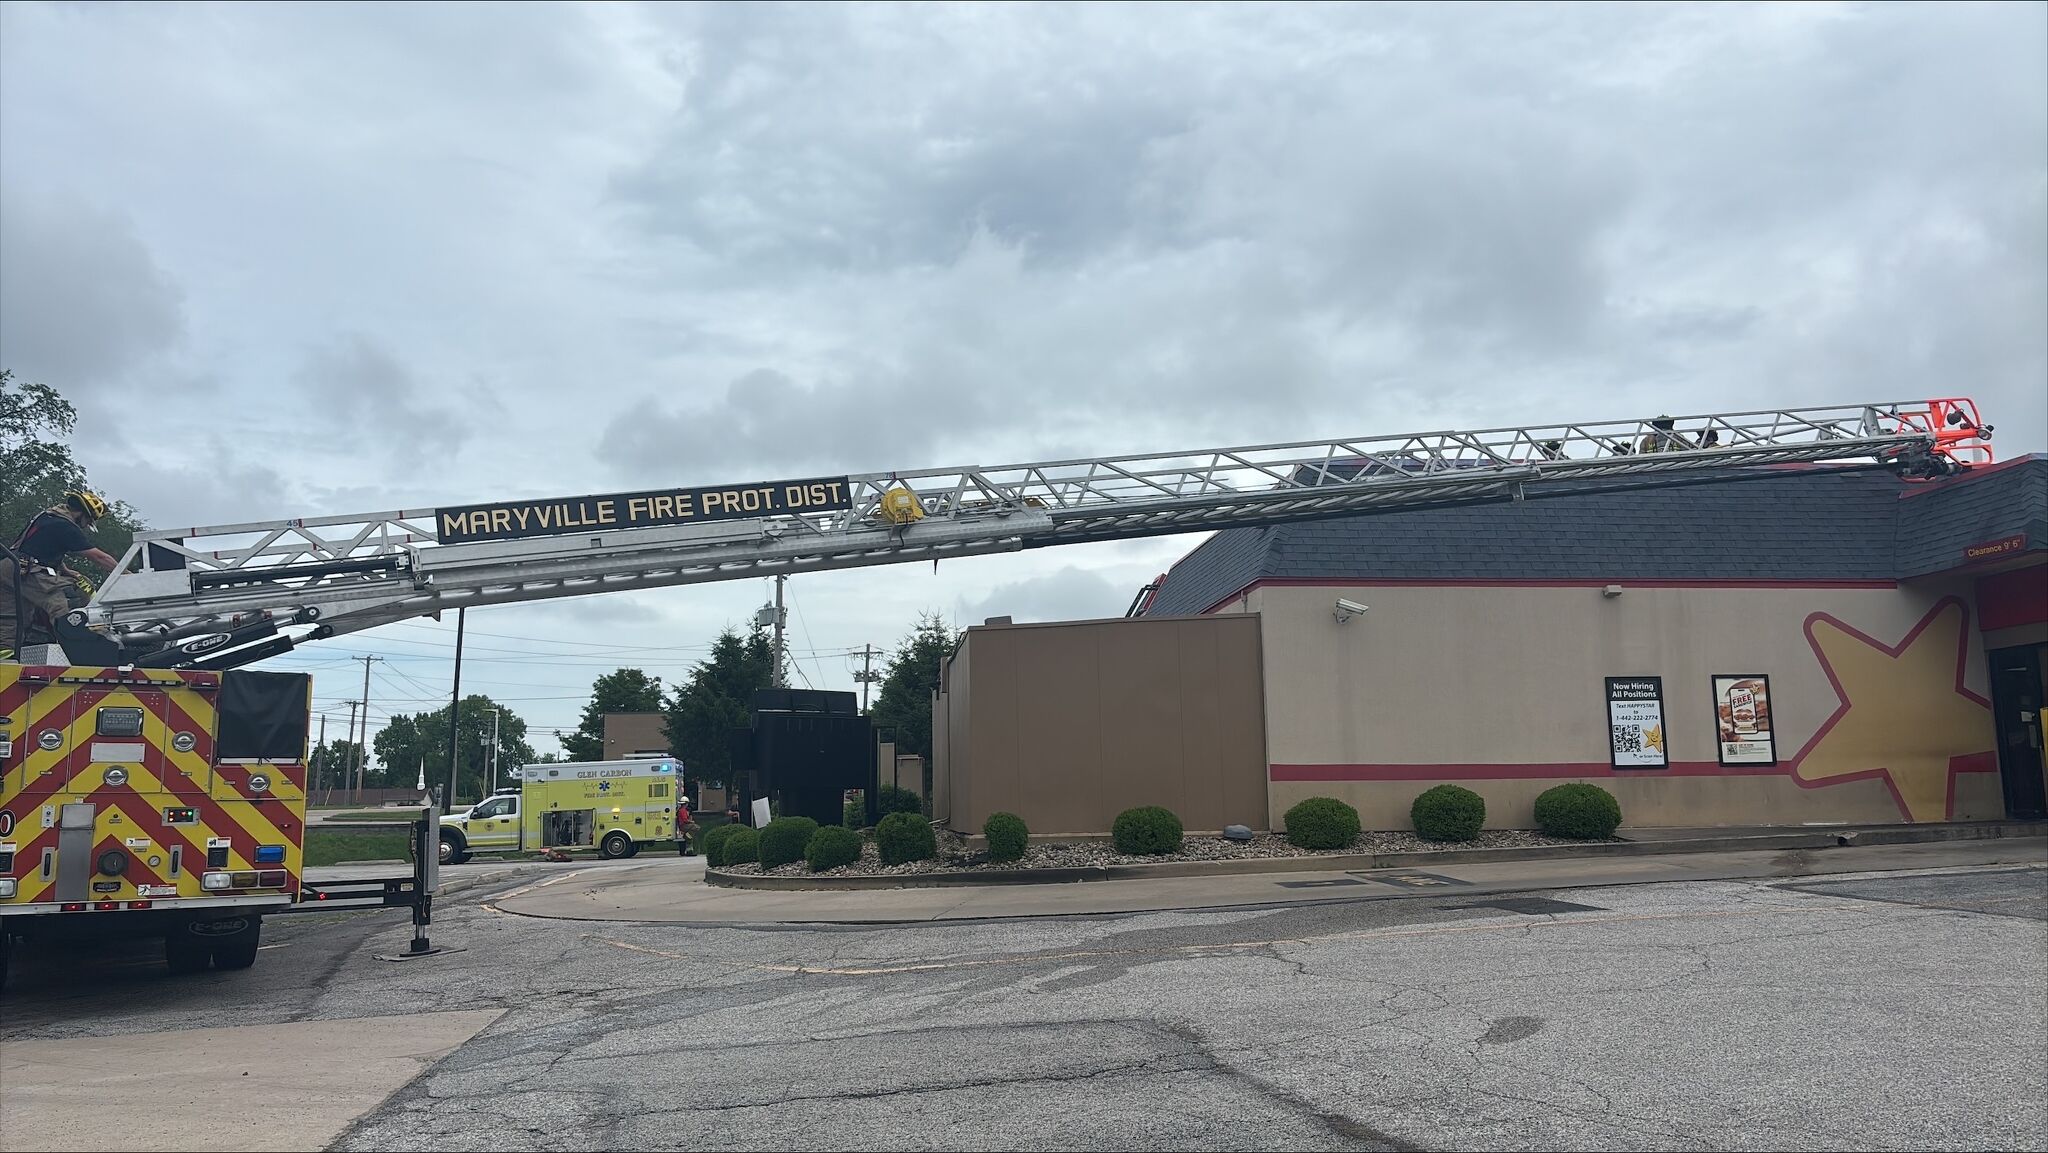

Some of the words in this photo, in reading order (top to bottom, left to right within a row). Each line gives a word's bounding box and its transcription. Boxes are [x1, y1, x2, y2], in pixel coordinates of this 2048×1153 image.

[443, 500, 617, 537] MARYVILLE
[628, 494, 694, 521] FIRE
[701, 487, 781, 515] PROT.
[785, 482, 847, 508] DIST.
[286, 519, 299, 527] 45
[1967, 545, 2002, 557] Clearance
[190, 635, 223, 651] E-ONE
[1631, 682, 1654, 691] Hiring
[1732, 693, 1752, 706] FREE
[600, 769, 632, 778] CARBON
